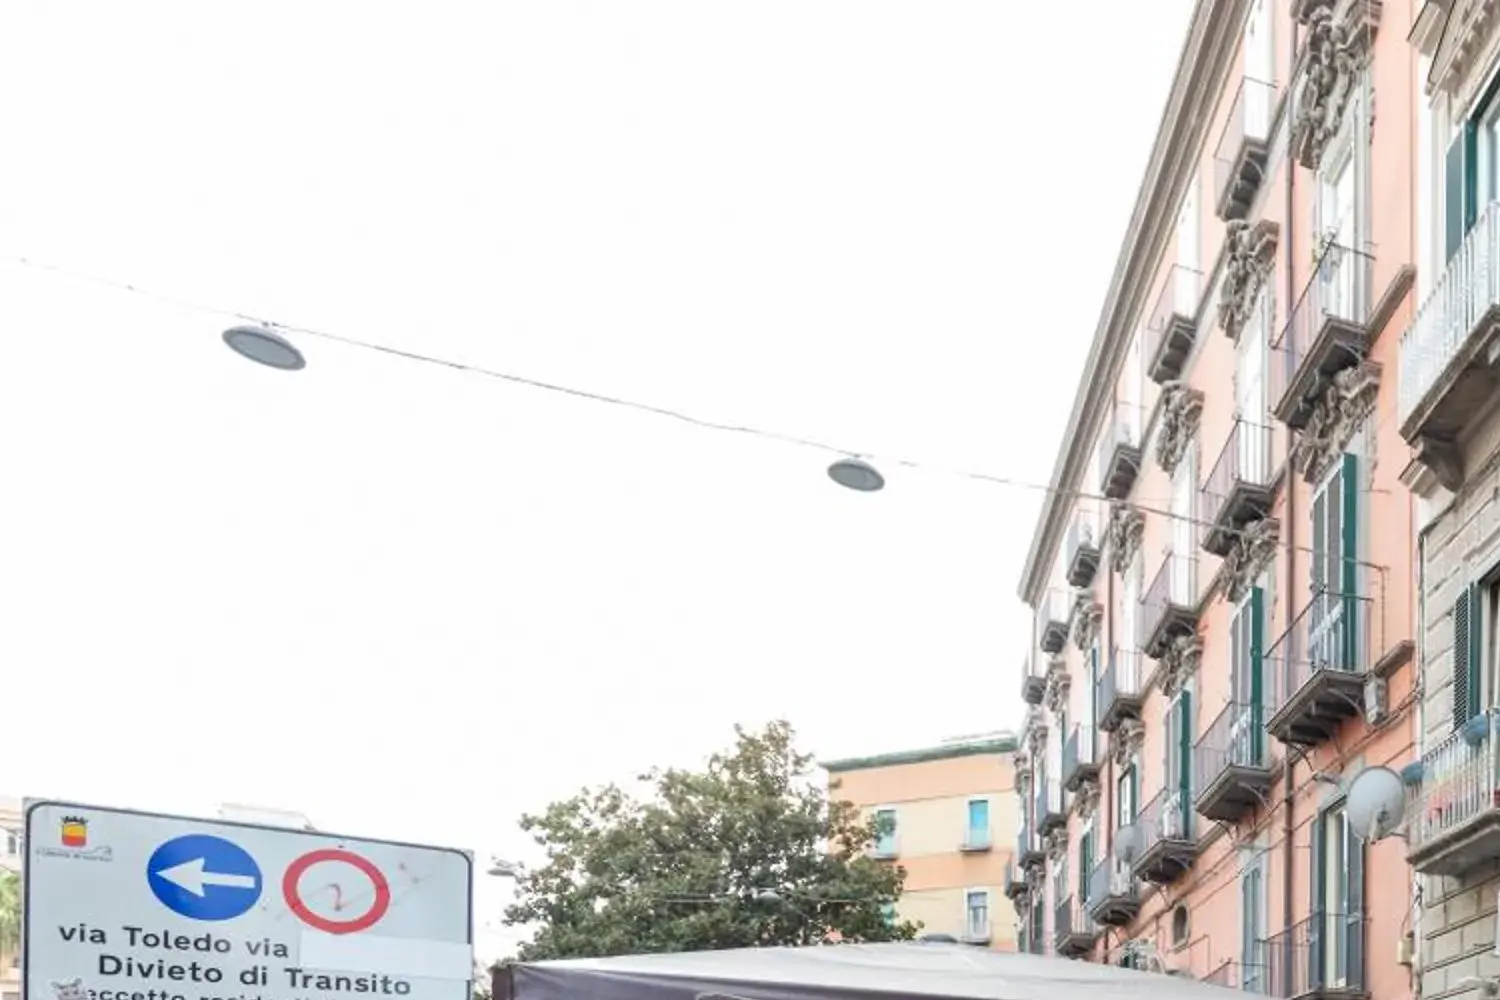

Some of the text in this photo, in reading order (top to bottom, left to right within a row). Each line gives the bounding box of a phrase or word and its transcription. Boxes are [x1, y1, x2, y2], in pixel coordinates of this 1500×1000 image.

[58, 923, 289, 958] via Toledo via
[99, 954, 411, 996] Divieto di Transito
